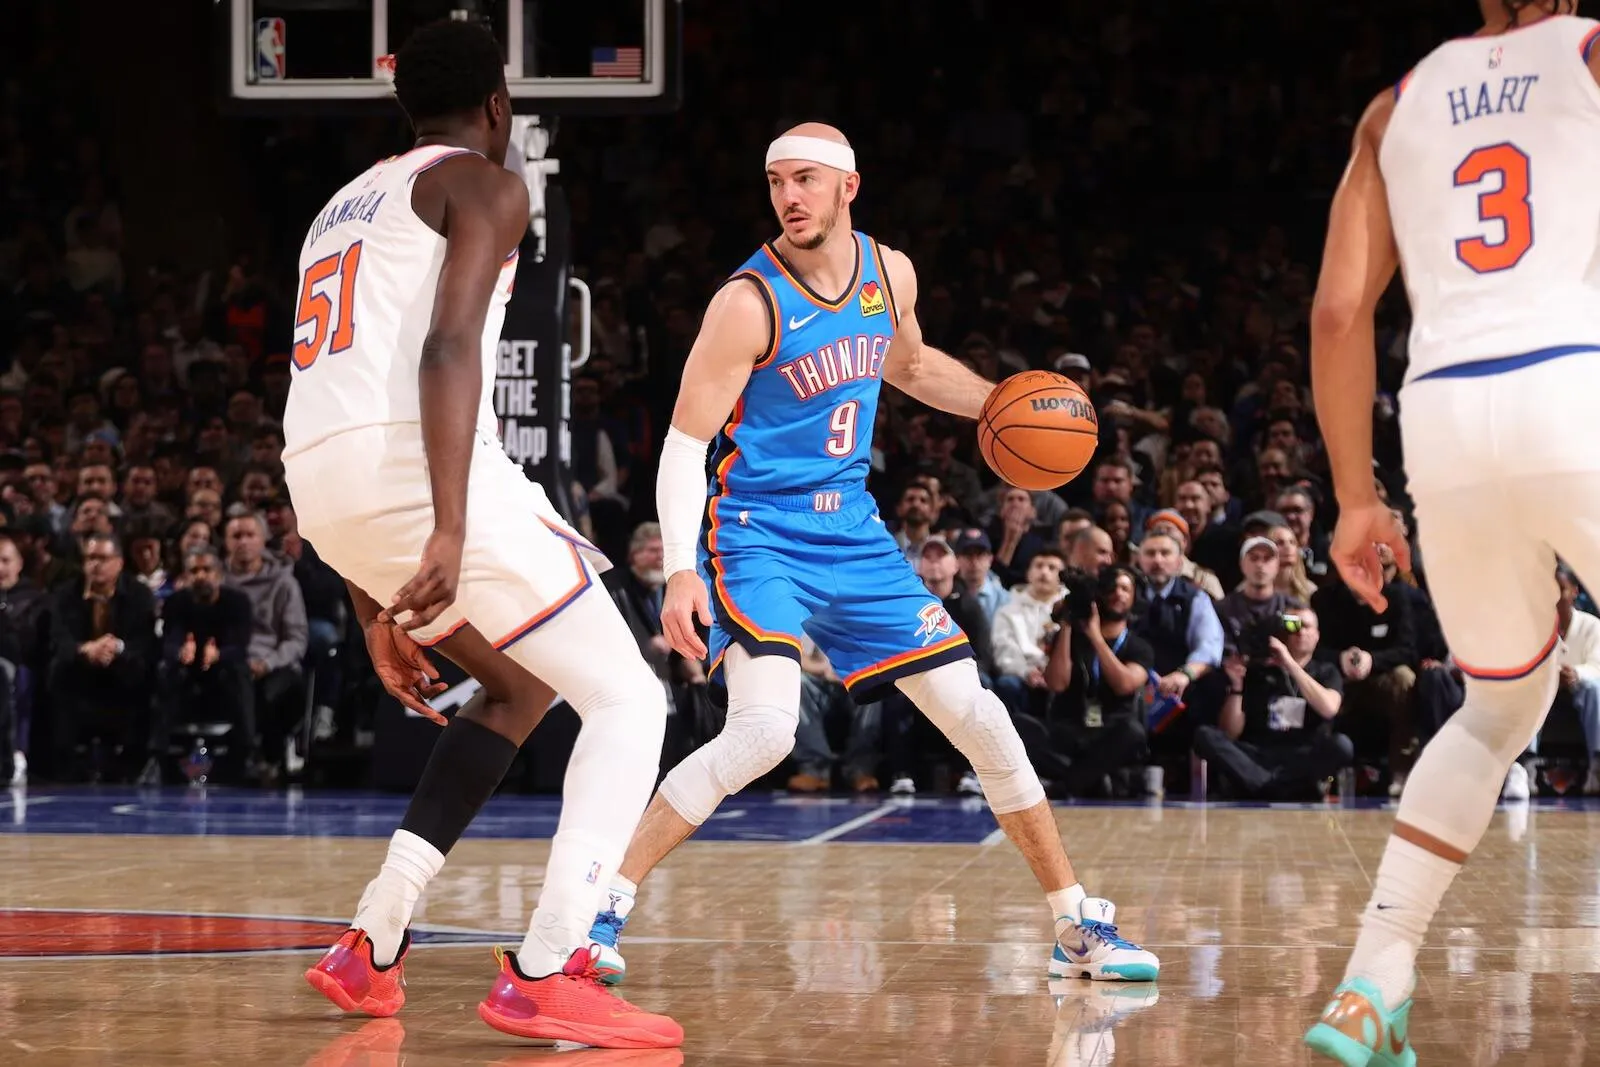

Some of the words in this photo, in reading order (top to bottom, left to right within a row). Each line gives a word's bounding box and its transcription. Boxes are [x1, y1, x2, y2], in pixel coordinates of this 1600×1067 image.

[1447, 74, 1539, 126] HART
[310, 190, 386, 248] DIAWARA
[1453, 140, 1535, 274] 3
[291, 239, 363, 371] 51
[862, 300, 884, 314] Love's
[496, 339, 539, 378] GET
[495, 378, 539, 417] THE
[503, 417, 548, 467] App
[825, 400, 859, 457] 9
[814, 492, 841, 512] OKC
